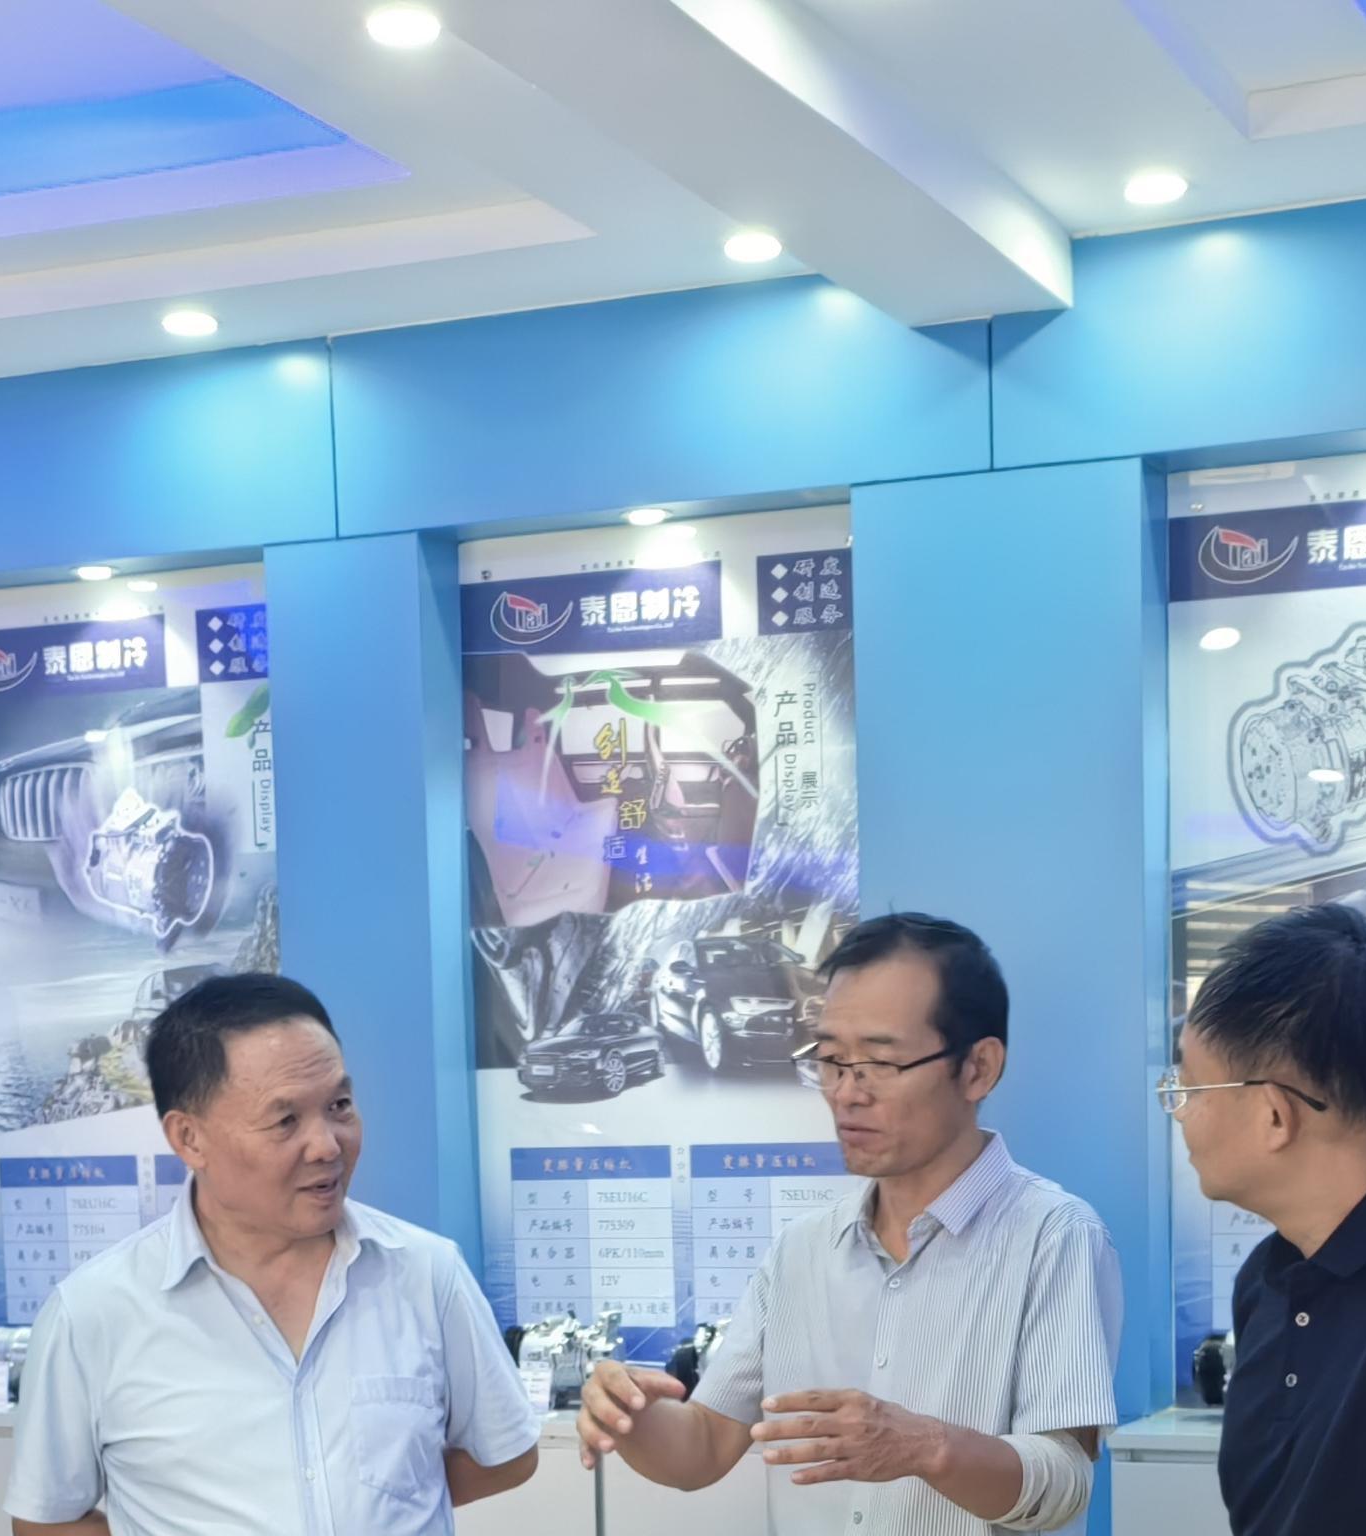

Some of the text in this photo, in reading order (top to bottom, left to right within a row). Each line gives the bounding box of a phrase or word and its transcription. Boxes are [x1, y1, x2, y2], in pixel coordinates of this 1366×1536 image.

[580, 585, 701, 627] 泰恩制冷
[43, 636, 148, 675] 泰恩制冷
[773, 690, 798, 746] 产品
[802, 682, 817, 745] Product
[259, 779, 273, 833] Display
[781, 754, 798, 812] Display
[800, 771, 819, 809] 展示
[600, 1274, 621, 1287] 12V
